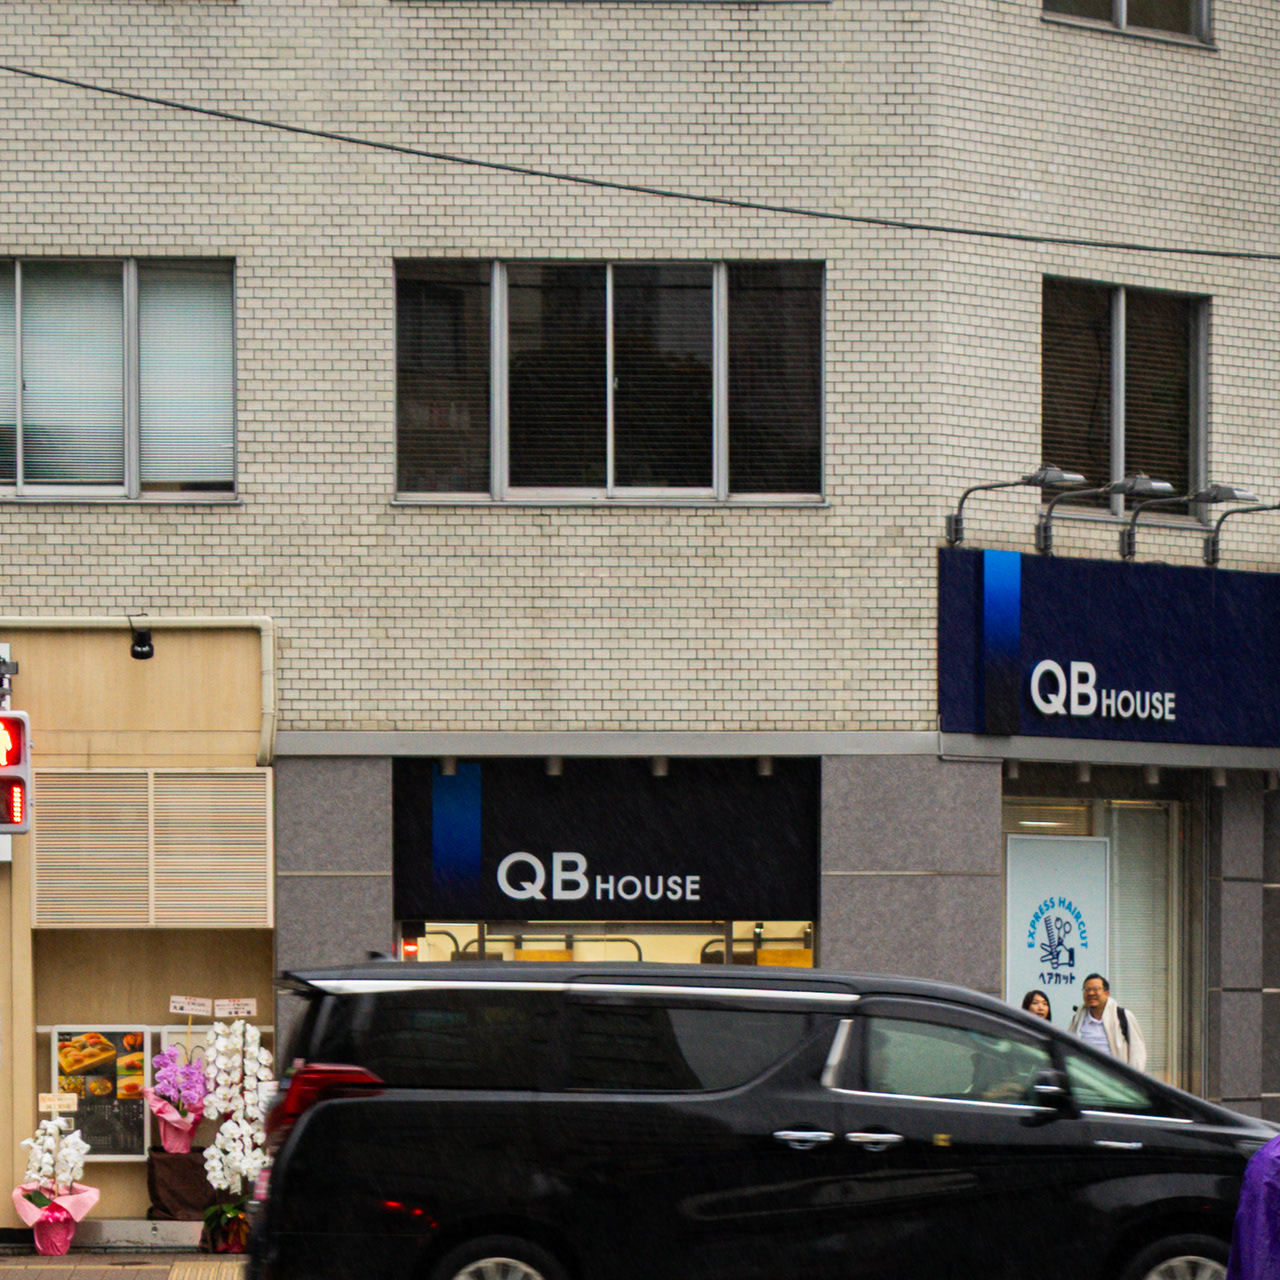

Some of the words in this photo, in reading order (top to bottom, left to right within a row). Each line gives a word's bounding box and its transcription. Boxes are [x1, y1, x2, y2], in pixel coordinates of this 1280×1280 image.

[1030, 659, 1098, 716] QB
[1101, 689, 1176, 720] HOUSE
[496, 851, 589, 900] QB
[595, 875, 701, 900] HOUSE
[1027, 897, 1055, 948] EXPRESS
[1058, 896, 1088, 949] HAIRCUT
[1039, 972, 1075, 985] ヘアカット
